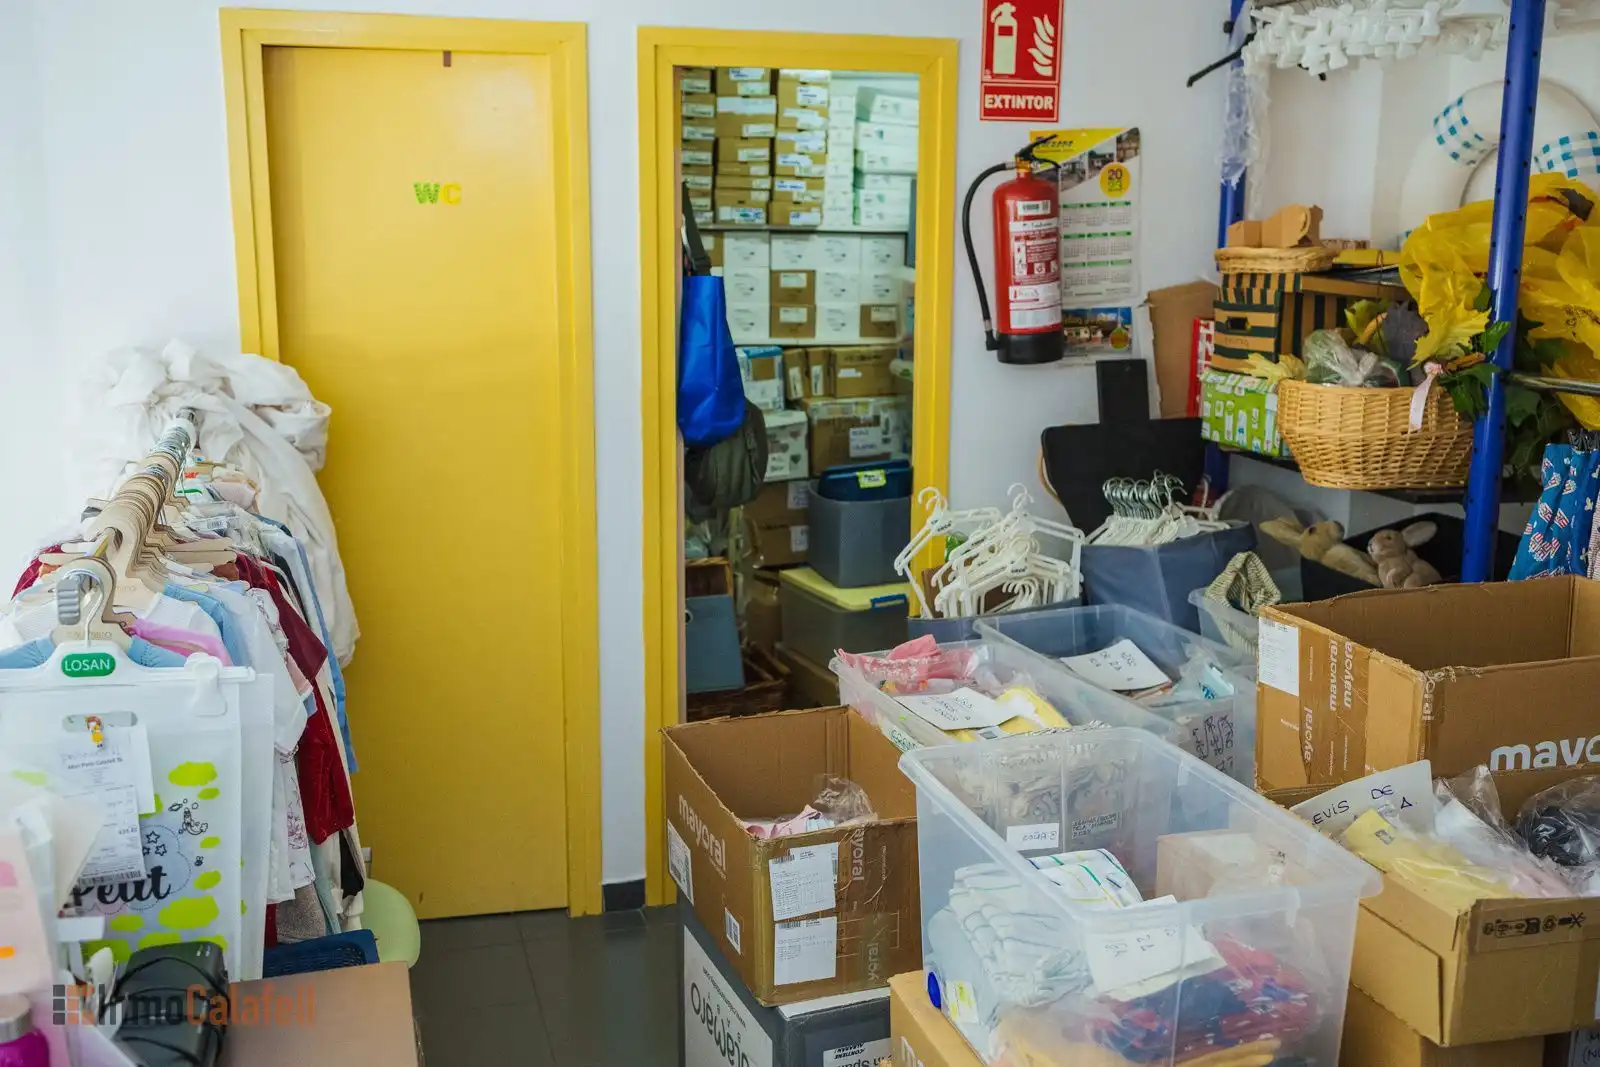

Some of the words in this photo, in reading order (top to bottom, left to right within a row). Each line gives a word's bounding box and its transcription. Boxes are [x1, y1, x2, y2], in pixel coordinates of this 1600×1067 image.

[984, 94, 1054, 110] EXTINTOR
[1107, 168, 1123, 180] 20
[413, 182, 462, 205] WC
[64, 659, 111, 672] LOSAN
[1421, 677, 1435, 721] oral
[1303, 706, 1314, 762] ayoral
[1371, 785, 1394, 800] DE
[679, 794, 726, 871] mayoral
[851, 828, 865, 881] ayoral
[866, 942, 880, 982] yoral
